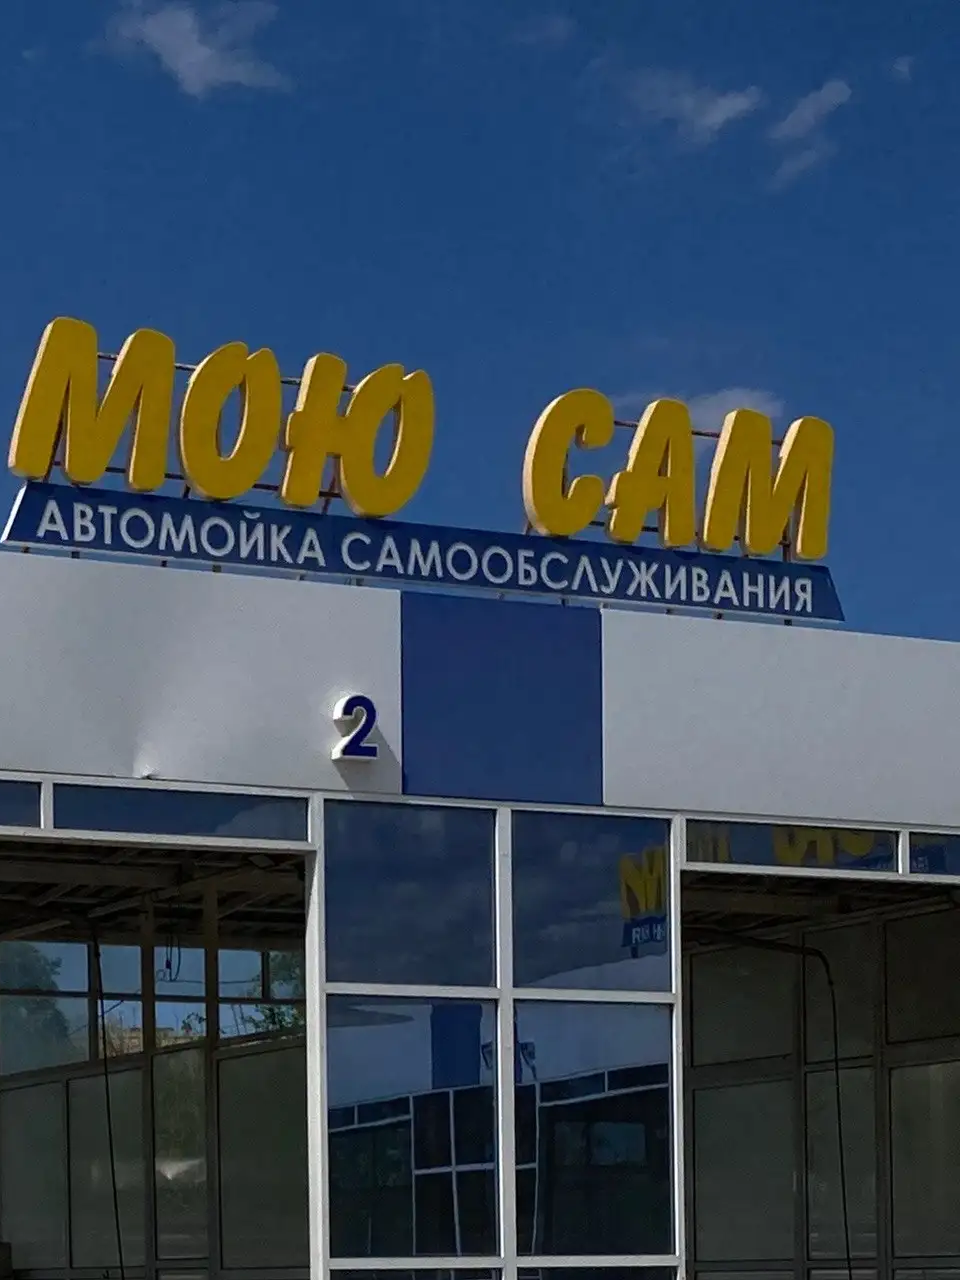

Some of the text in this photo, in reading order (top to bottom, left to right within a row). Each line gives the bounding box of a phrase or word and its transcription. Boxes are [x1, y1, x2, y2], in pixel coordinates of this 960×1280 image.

[8, 316, 835, 560] МОЮ САМ
[36, 498, 815, 614] АВТОМОЙКА САМООБСЛУЖИВАНИЯ
[337, 693, 378, 759] 2
